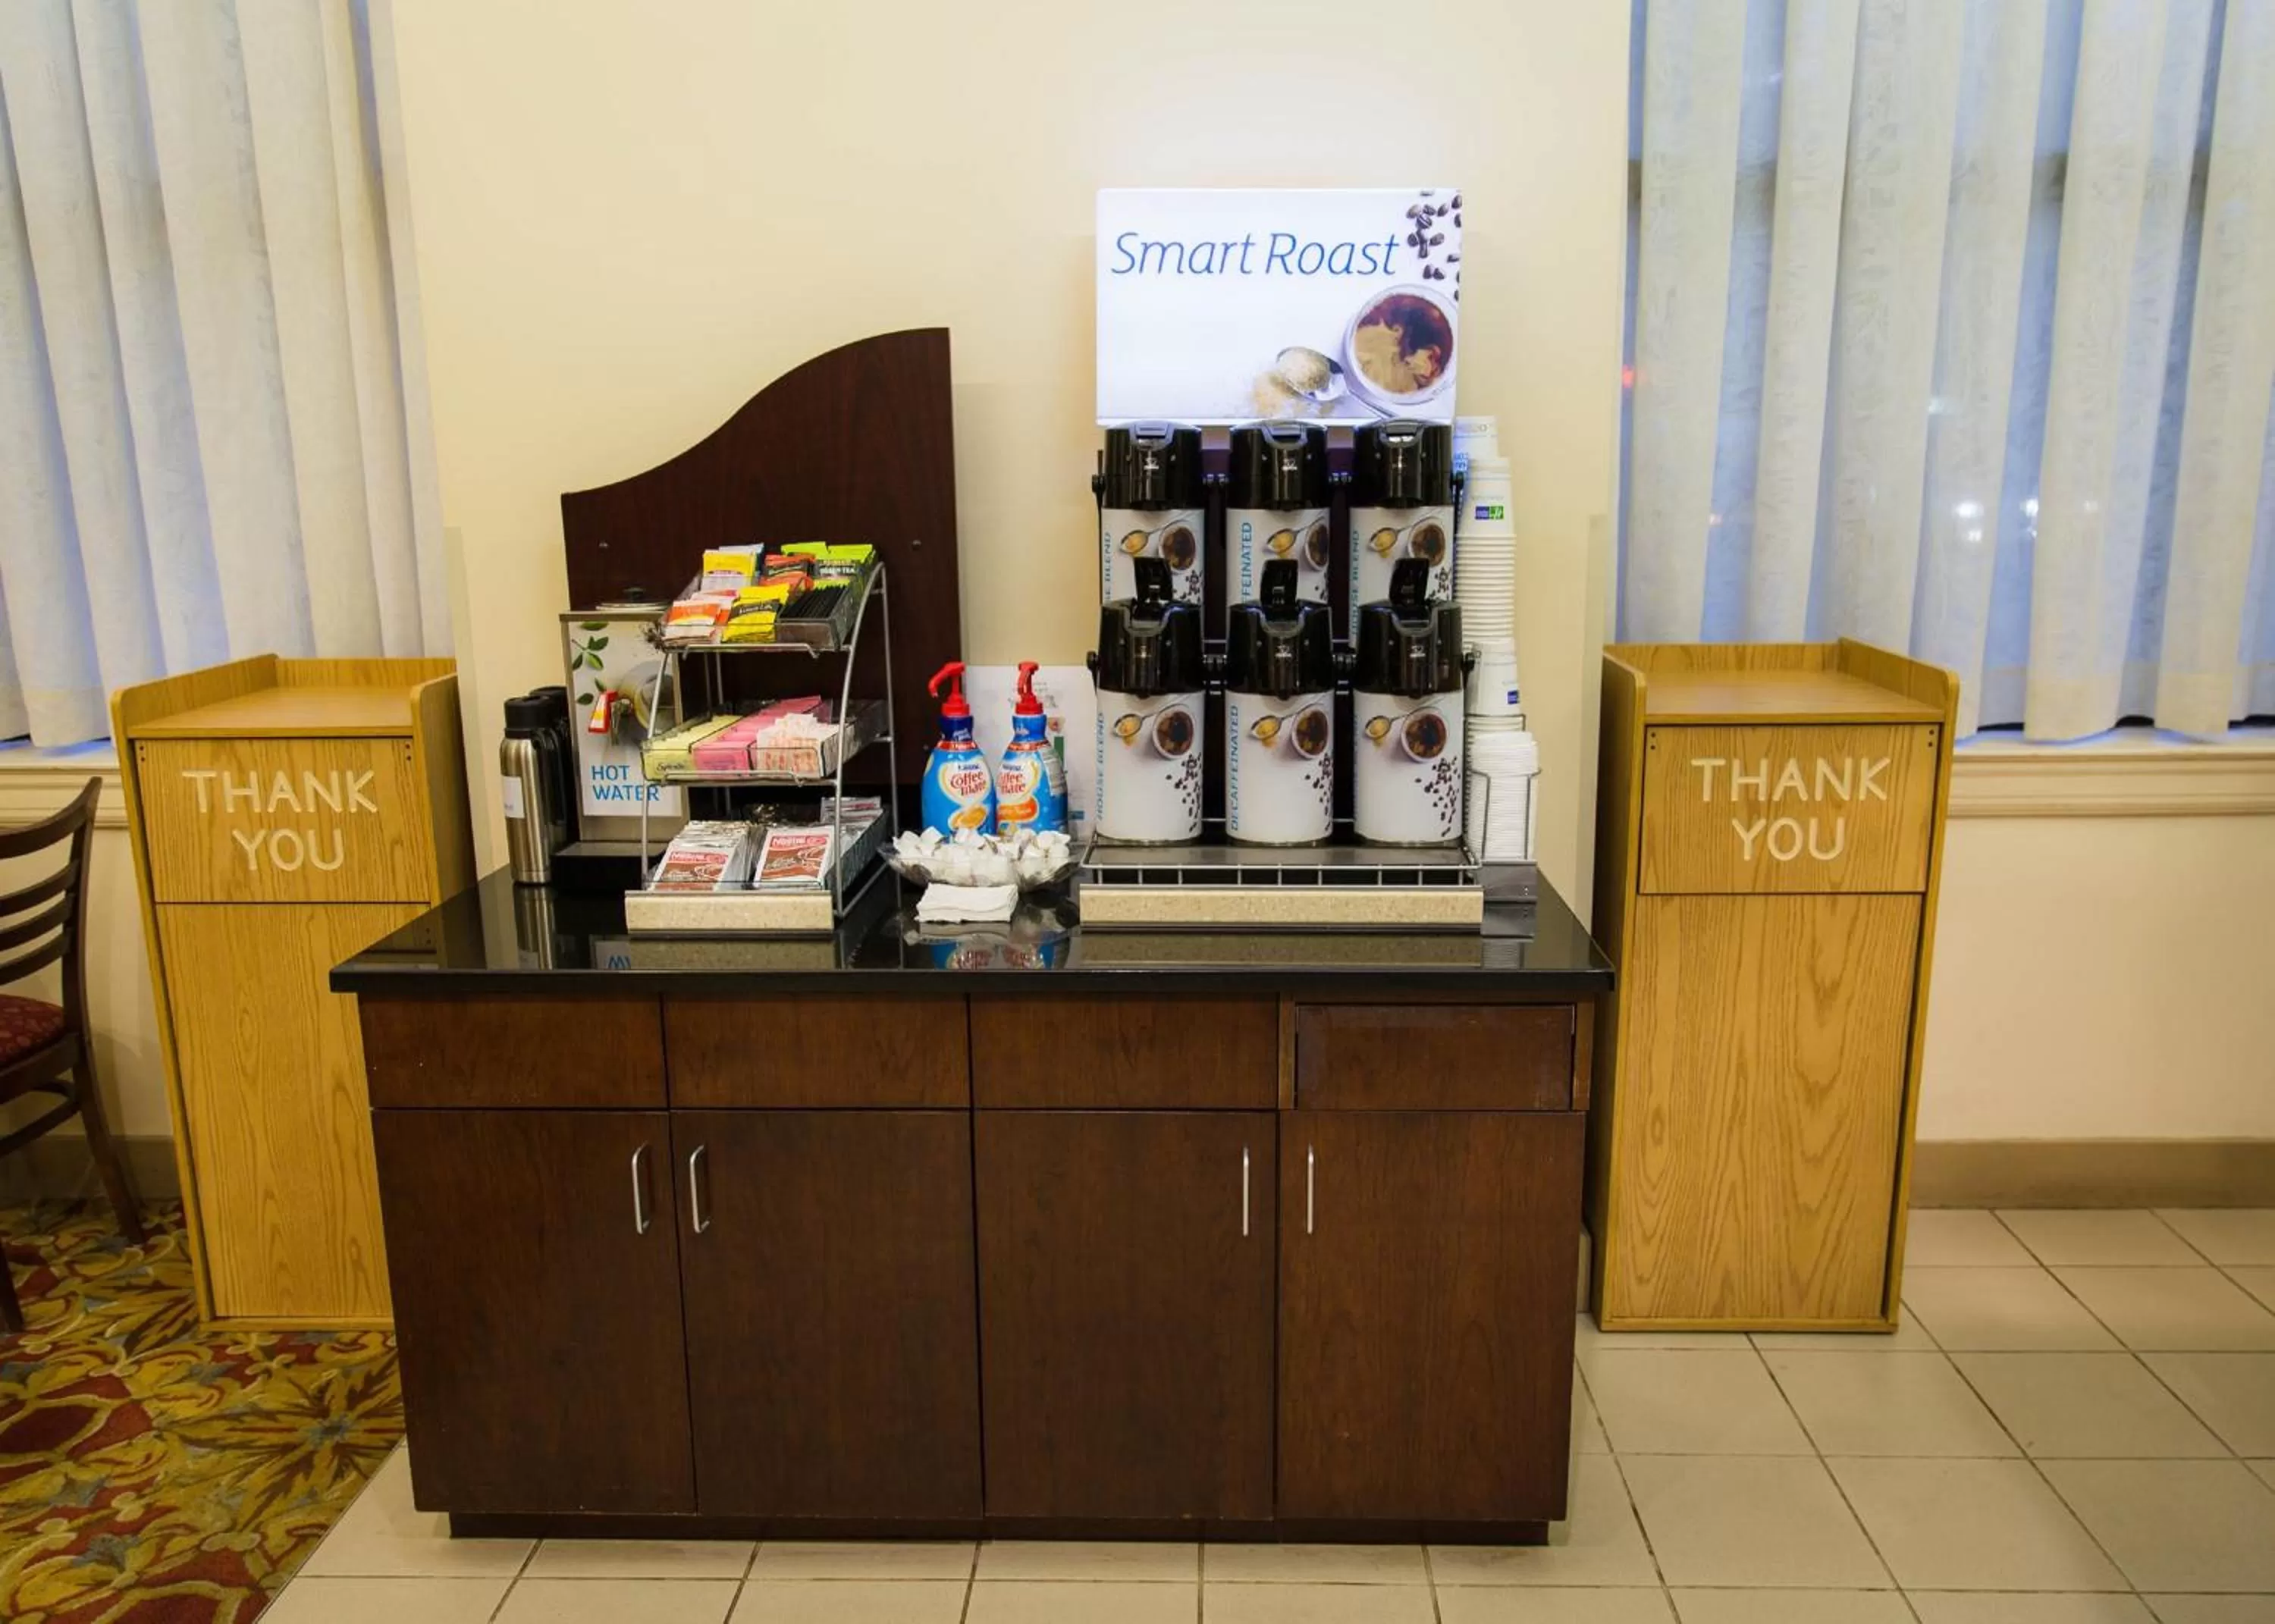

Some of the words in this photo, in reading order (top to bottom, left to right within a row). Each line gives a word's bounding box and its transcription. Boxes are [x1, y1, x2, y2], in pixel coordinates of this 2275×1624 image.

[1111, 231, 1256, 276] Smart
[1265, 232, 1400, 276] Roast
[181, 770, 378, 814] THANK
[592, 765, 631, 781] HOT
[592, 784, 660, 801] WATER
[950, 771, 984, 789] Coffee
[1690, 757, 1891, 802] THANK
[231, 828, 345, 871] YOU
[1731, 817, 1845, 861] YOU
